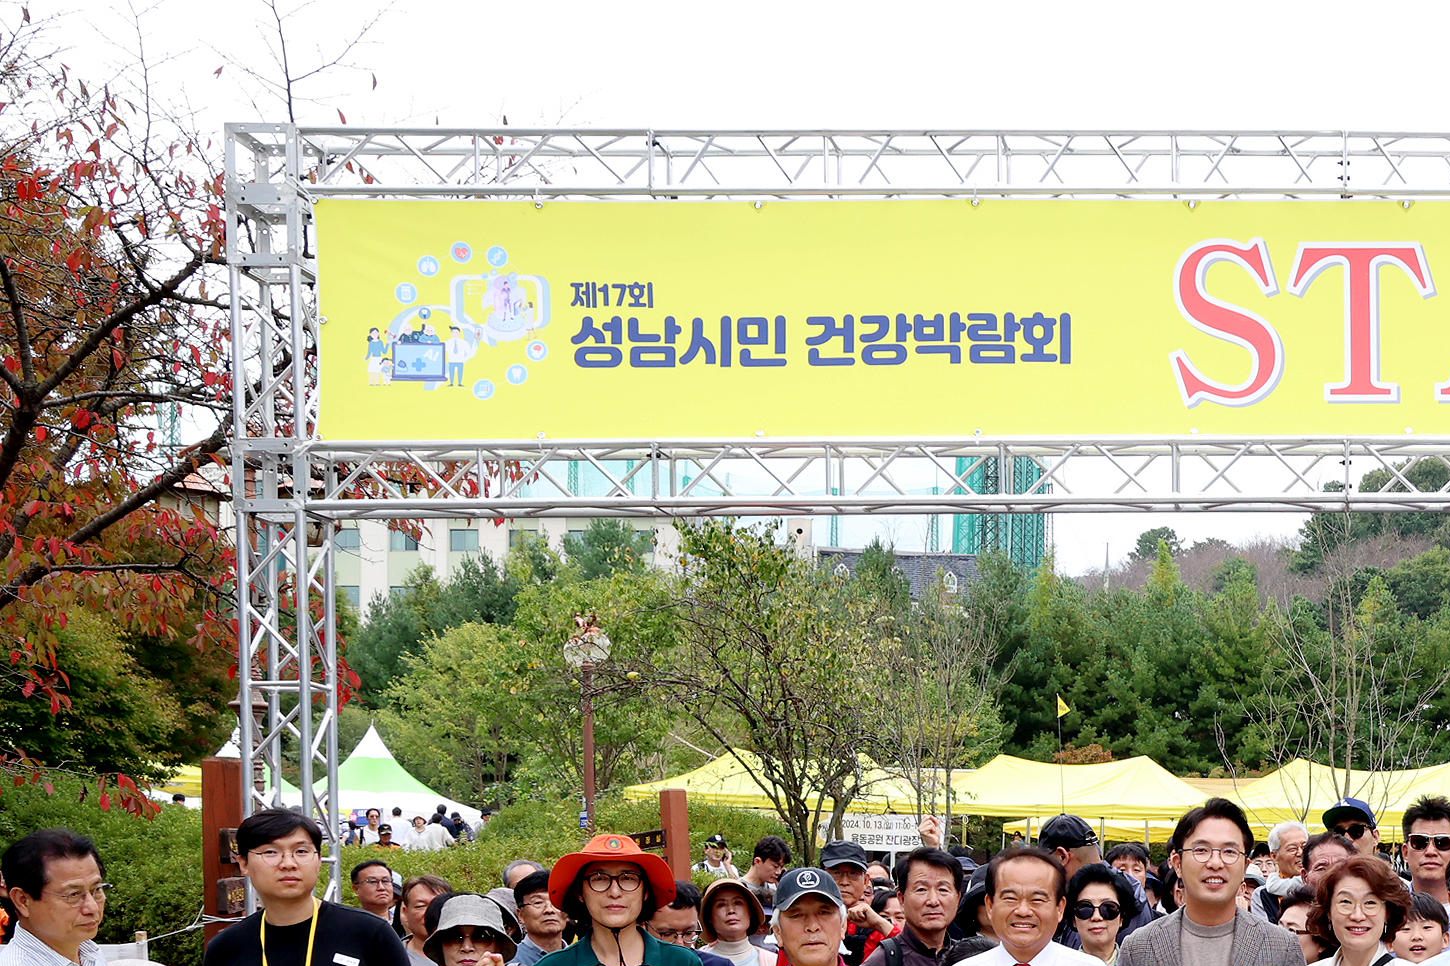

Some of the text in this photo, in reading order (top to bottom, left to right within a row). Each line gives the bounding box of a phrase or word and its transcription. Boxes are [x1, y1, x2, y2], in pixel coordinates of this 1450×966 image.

[570, 282, 653, 308] 제17회
[571, 312, 1071, 368] 성남시민 건강박람회
[423, 348, 440, 362] AI
[863, 820, 872, 829] 10.
